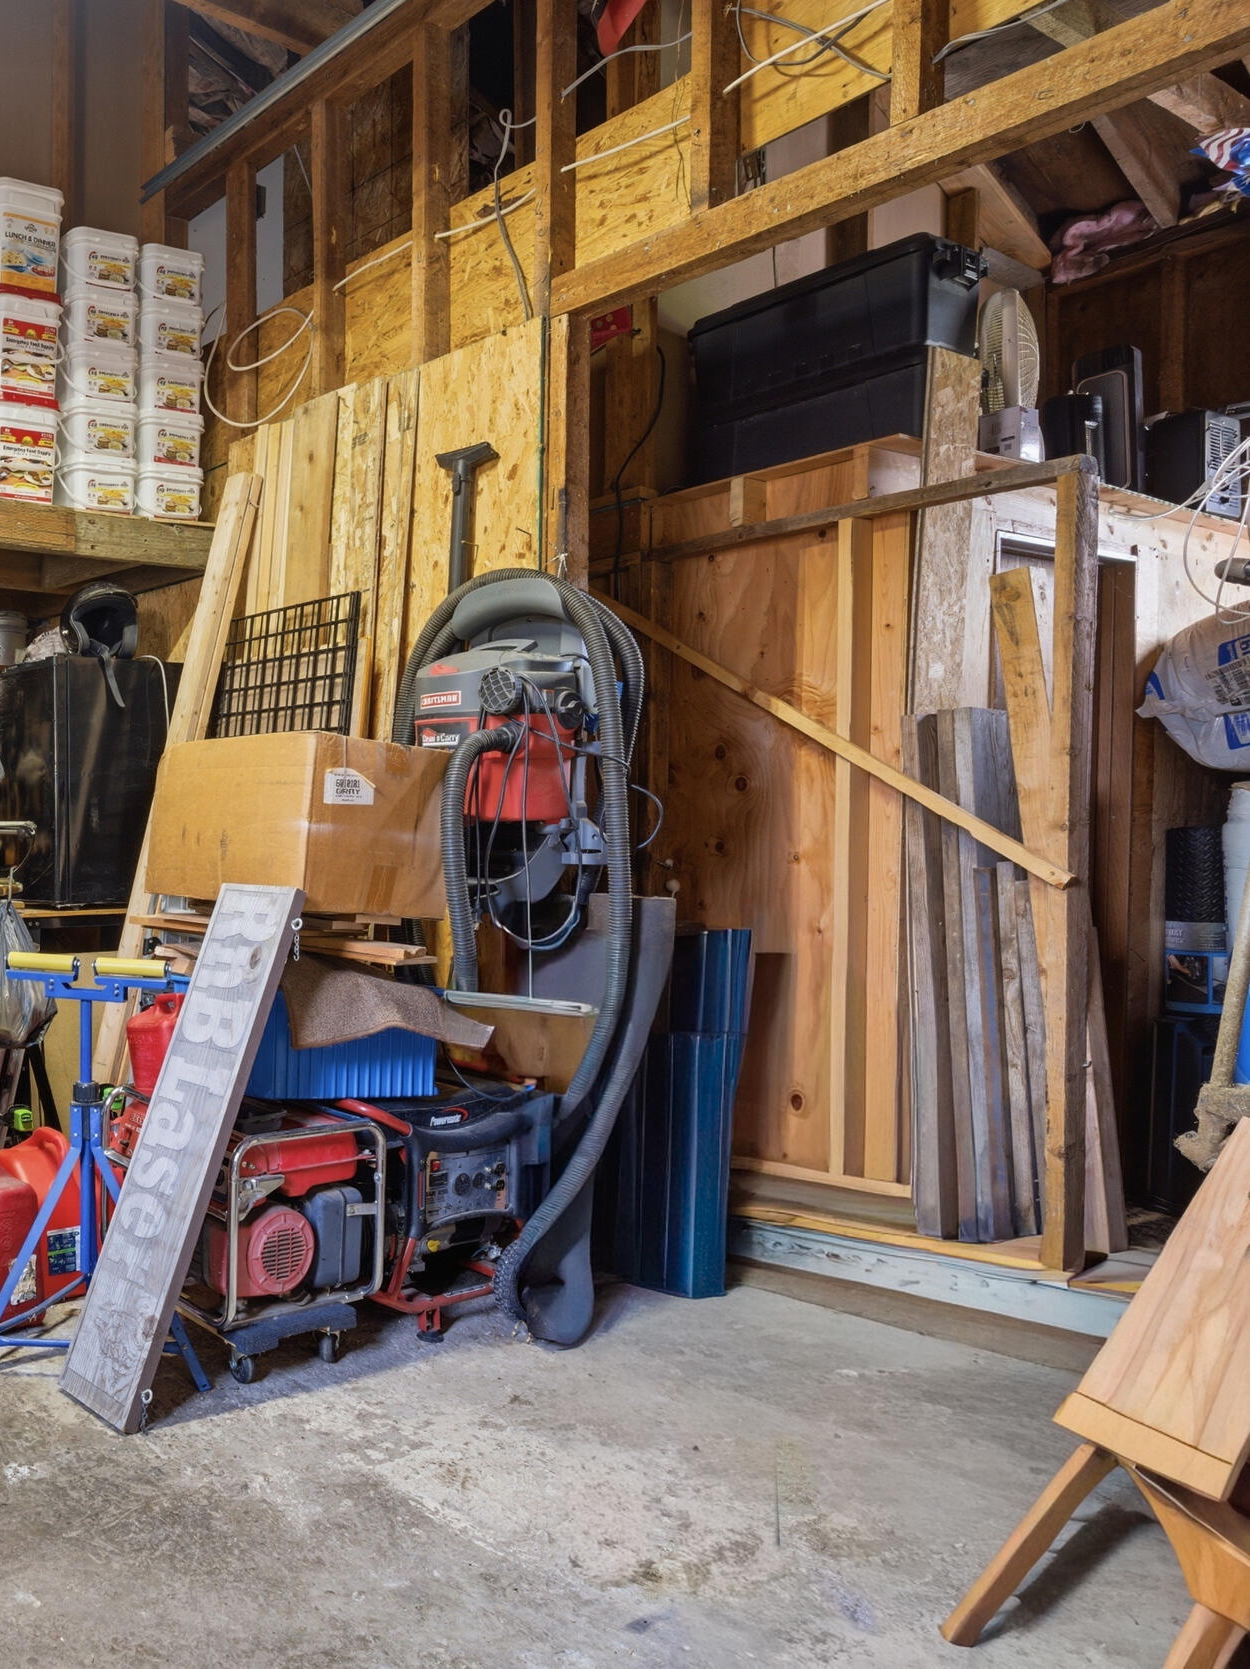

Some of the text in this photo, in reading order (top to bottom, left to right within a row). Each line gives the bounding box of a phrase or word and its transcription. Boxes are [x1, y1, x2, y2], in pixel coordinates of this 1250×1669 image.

[5, 231, 27, 242] LUNCH
[33, 237, 56, 248] DINNER
[5, 337, 29, 347] Emergency
[3, 445, 26, 454] Emergency
[100, 1055, 234, 1277] Laser
